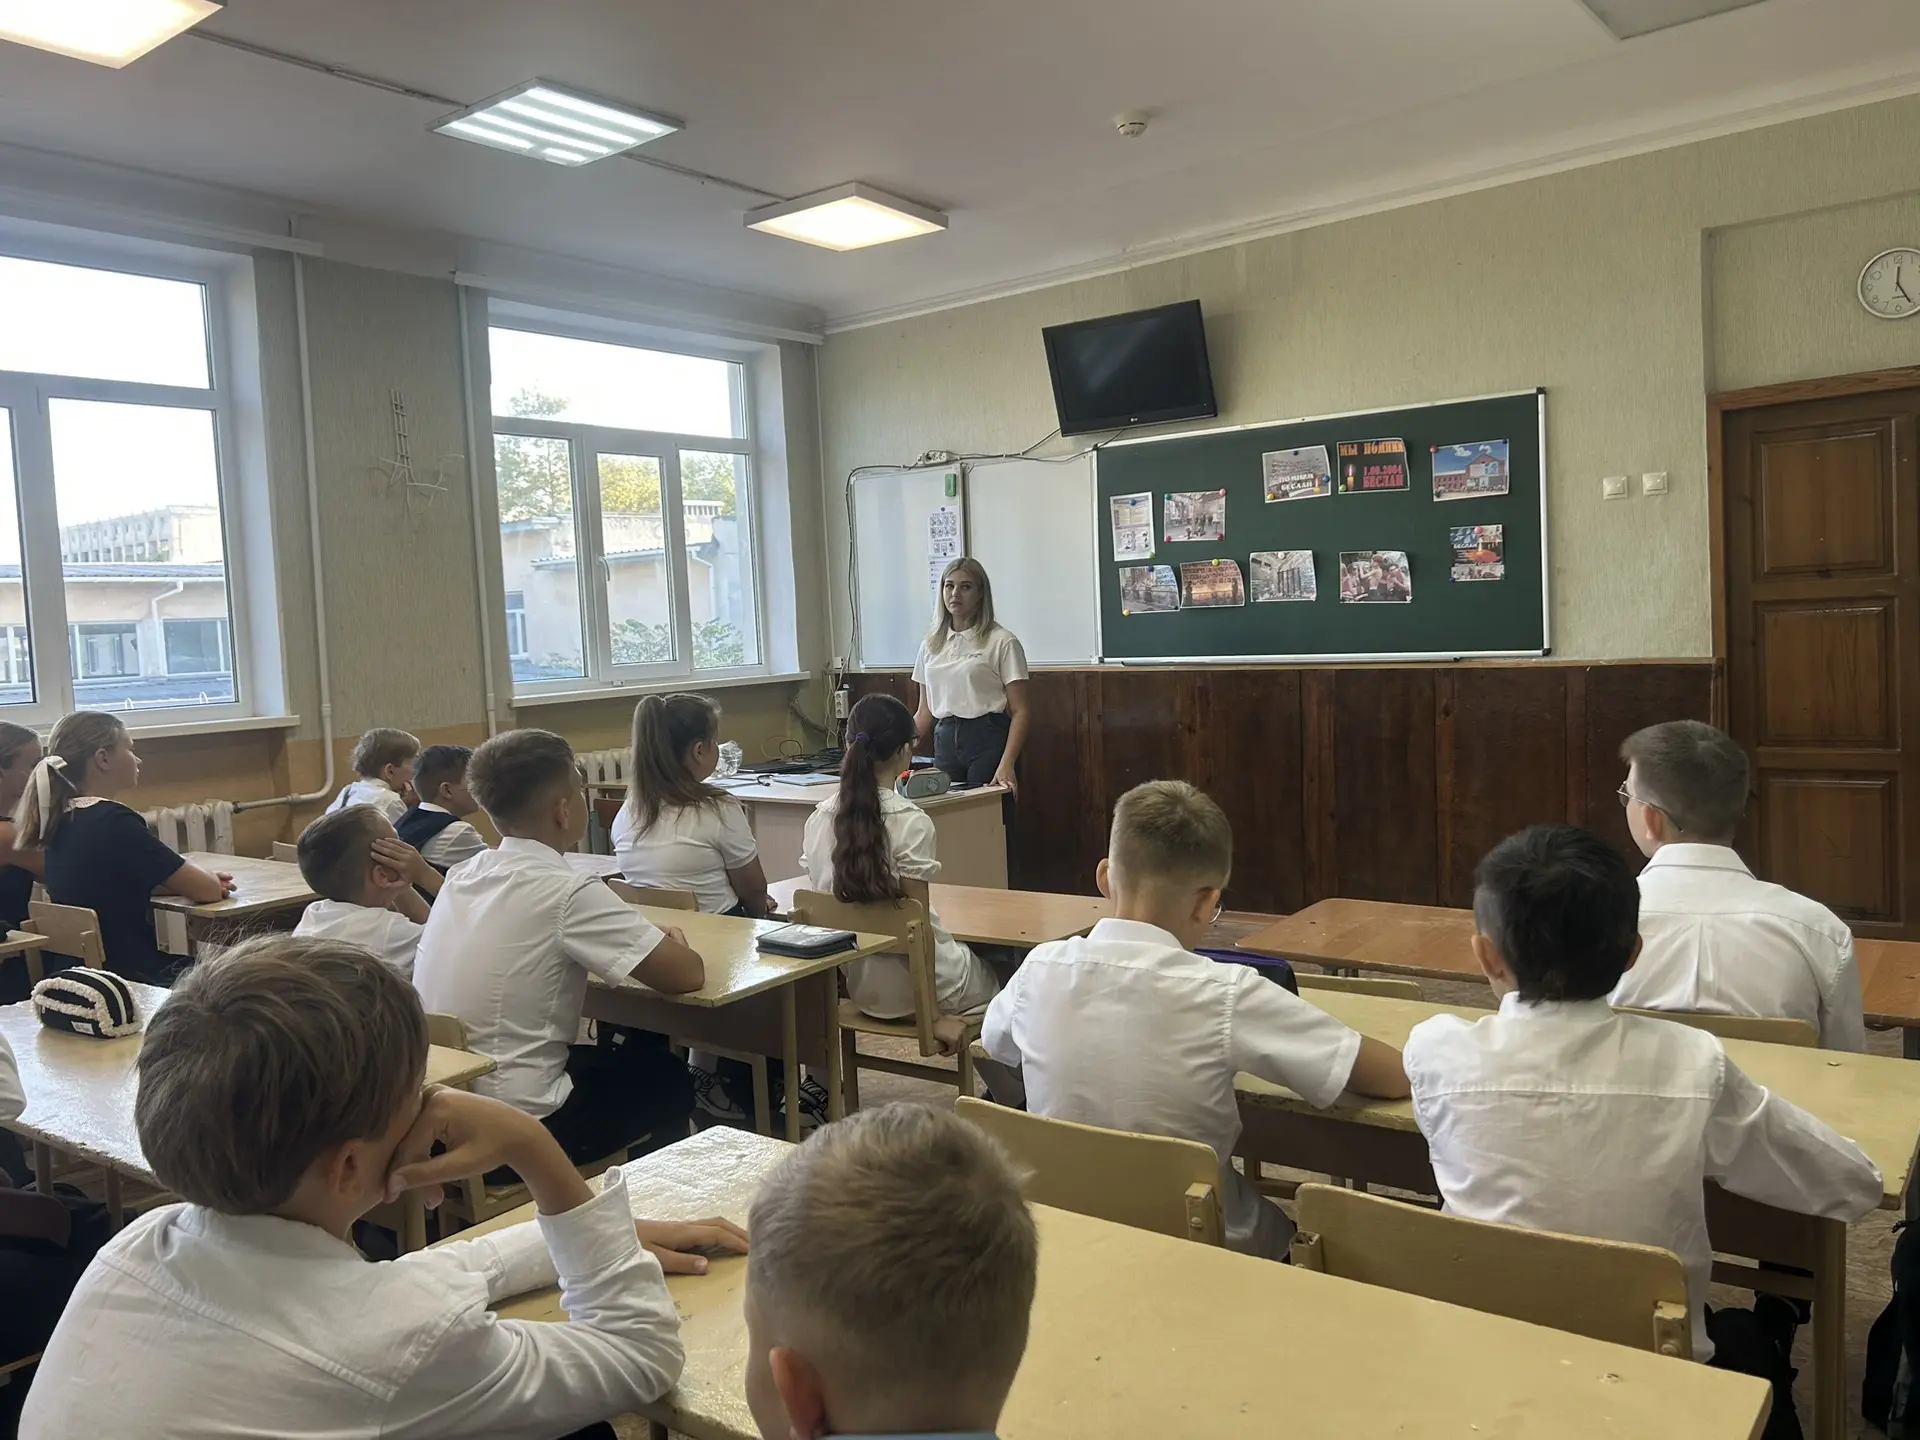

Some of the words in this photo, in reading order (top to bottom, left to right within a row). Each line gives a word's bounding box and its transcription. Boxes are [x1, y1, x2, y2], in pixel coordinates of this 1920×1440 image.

[1870, 270, 1882, 281] 10
[1866, 283, 1873, 292] 9
[1872, 294, 1879, 304] 8
[1881, 300, 1890, 314] 7
[1340, 444, 1358, 457] МЫ
[1363, 474, 1404, 488] БЕСЛАН
